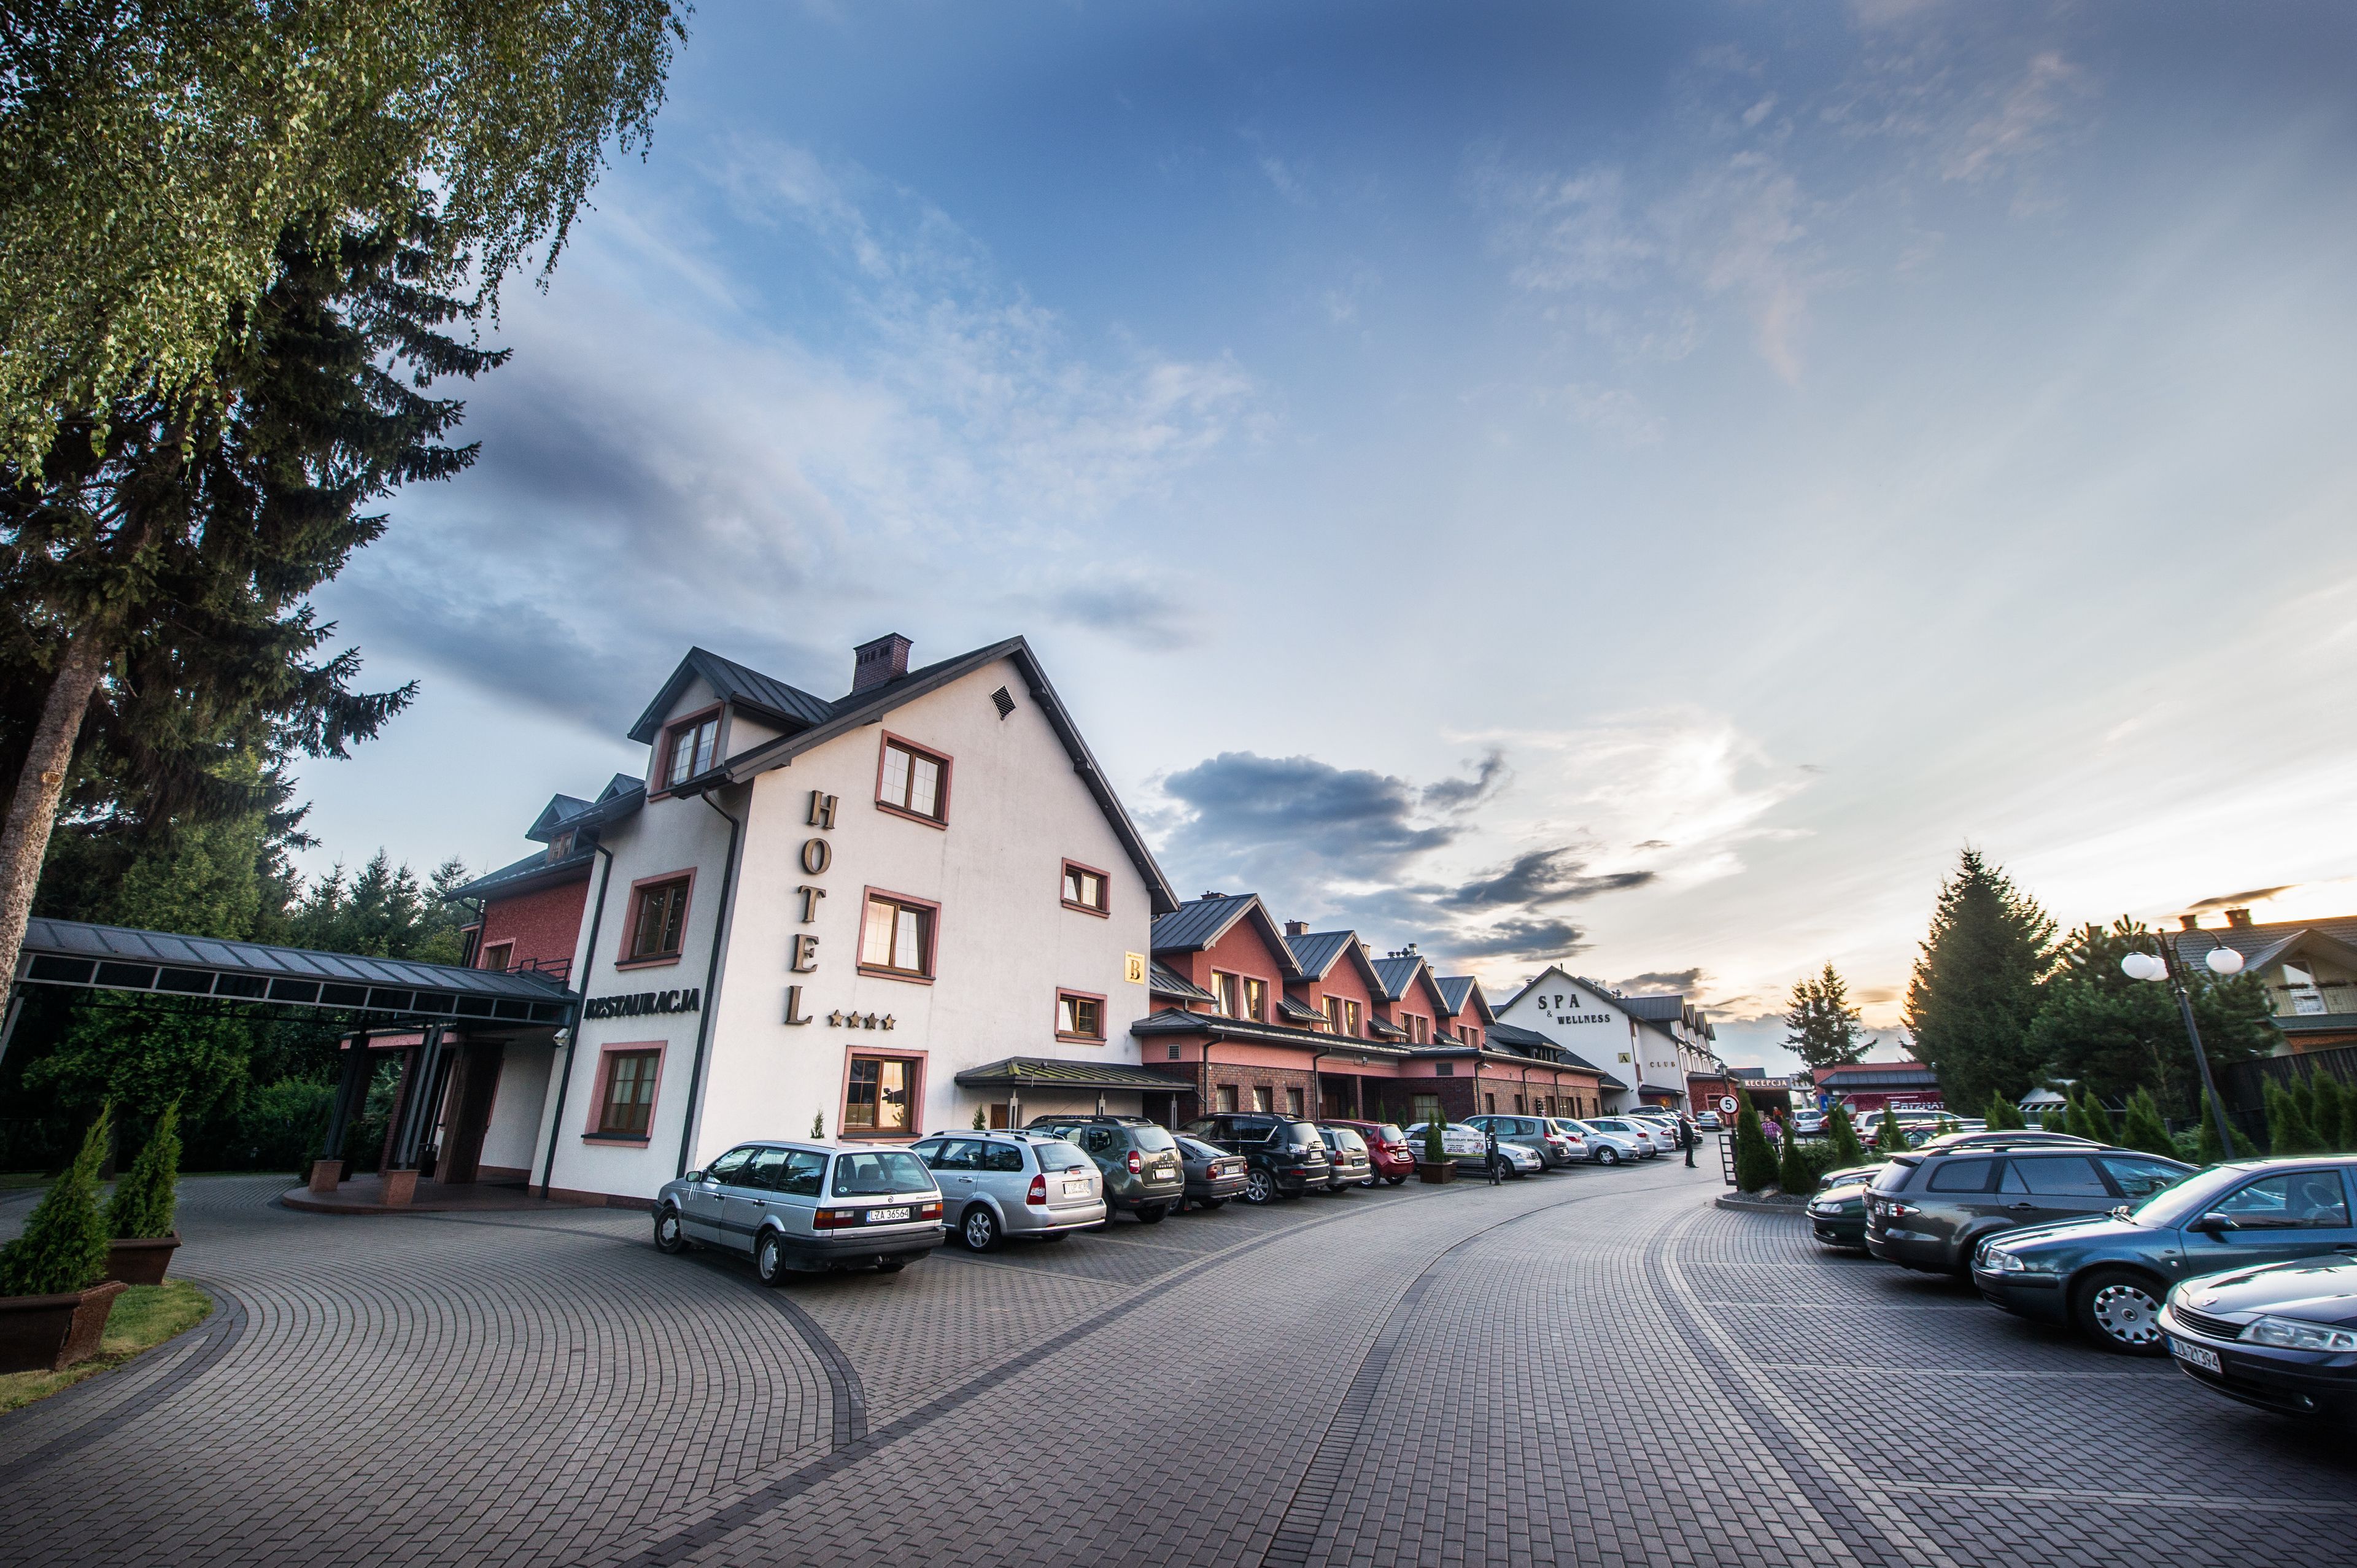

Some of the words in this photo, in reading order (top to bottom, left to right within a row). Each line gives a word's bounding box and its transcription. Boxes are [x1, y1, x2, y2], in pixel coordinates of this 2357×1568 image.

[785, 790, 840, 1025] HOTEL
[1130, 959, 1140, 980] B
[583, 988, 700, 1019] RESTAURACJA
[1538, 994, 1580, 1010] SPA
[1557, 1014, 1611, 1025] WELLNESS
[1725, 1100, 1732, 1110] 5
[871, 1211, 884, 1220] LZA
[886, 1209, 908, 1219] 36564
[2187, 1345, 2220, 1371] 21394
